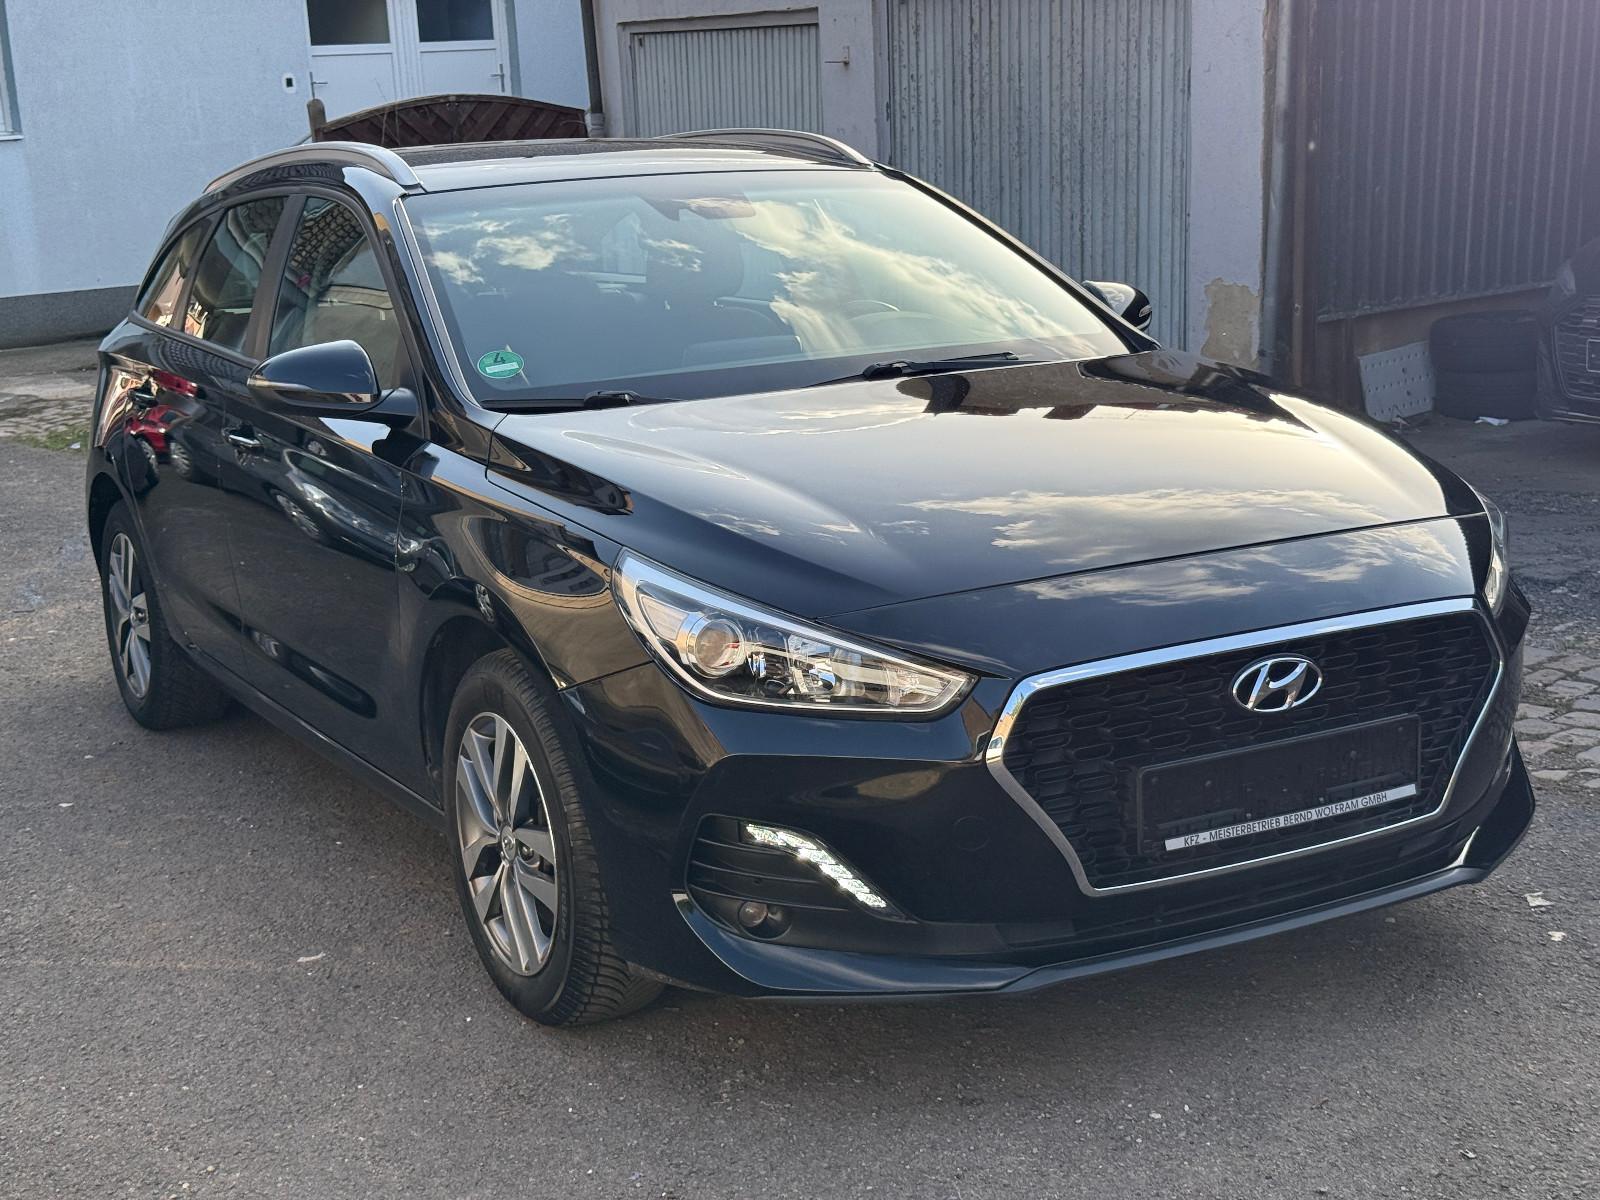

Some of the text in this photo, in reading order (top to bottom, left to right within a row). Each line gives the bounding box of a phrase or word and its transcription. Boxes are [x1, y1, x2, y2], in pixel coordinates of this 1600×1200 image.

[493, 352, 506, 364] 4
[1183, 835, 1200, 847] KFZ
[1209, 818, 1281, 842] MEISTERBETRIEB
[1283, 810, 1313, 826] BERND
[1314, 800, 1360, 819] WOLFRAM
[1361, 791, 1388, 808] GMBH
